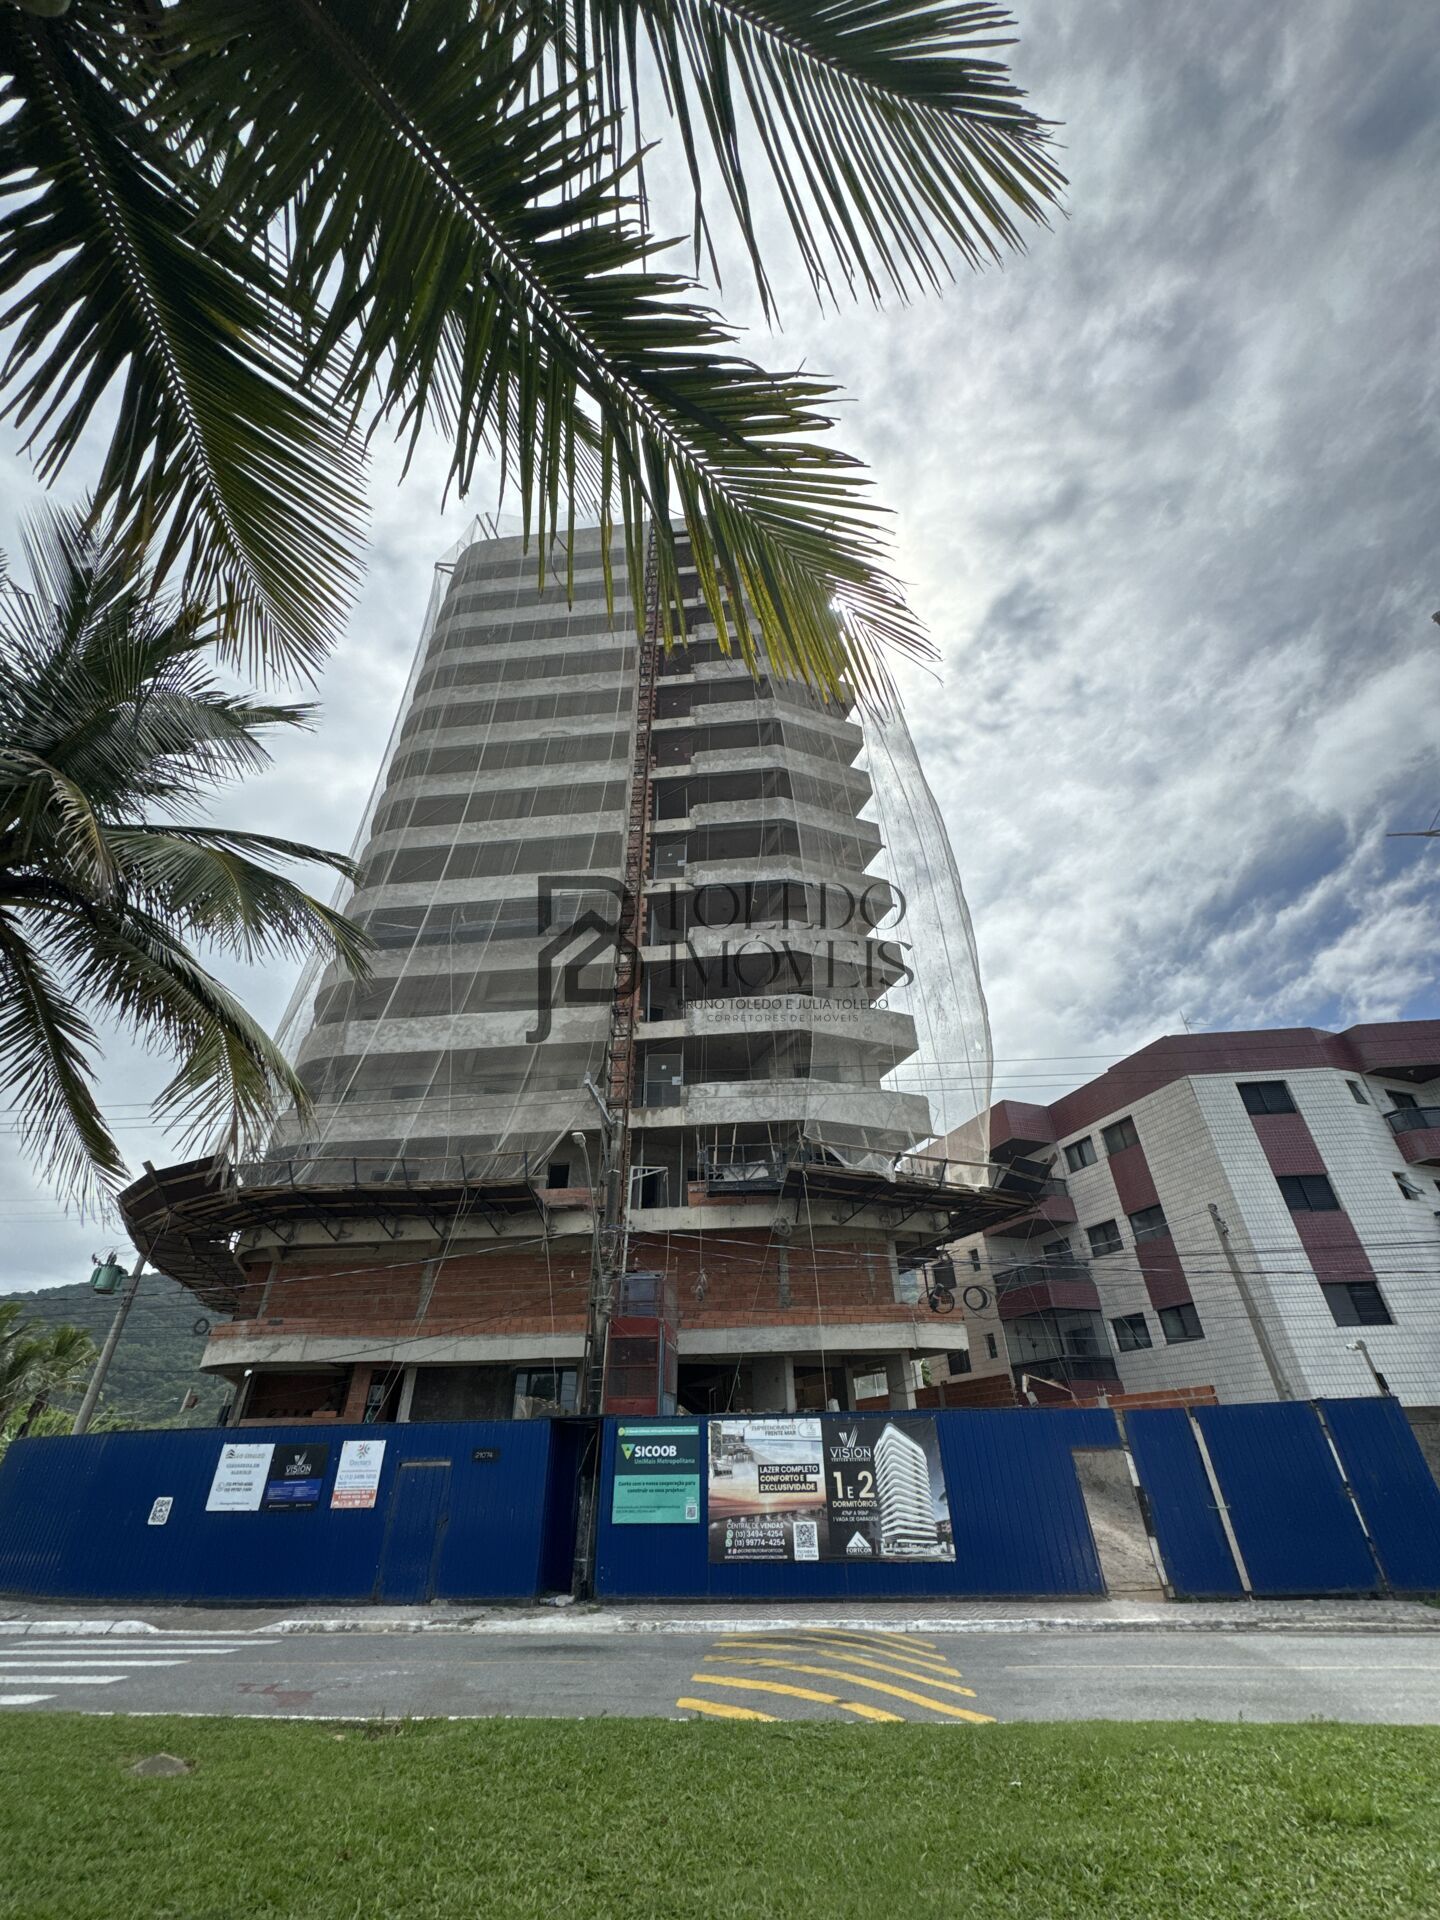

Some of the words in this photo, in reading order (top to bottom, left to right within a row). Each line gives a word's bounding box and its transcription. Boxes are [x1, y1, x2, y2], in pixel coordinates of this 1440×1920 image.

[634, 1445, 677, 1458] SICOOB
[830, 1447, 871, 1458] VISION
[657, 1457, 696, 1466] Metropolitana
[286, 1464, 312, 1473] VISION
[781, 1465, 819, 1473] COMPLETO
[760, 1474, 800, 1482] CONFORTO
[800, 1474, 805, 1482] E
[760, 1483, 816, 1491] EXCLUSIVIDADE
[833, 1471, 844, 1499] 1
[847, 1486, 855, 1499] E
[857, 1470, 876, 1498] 2
[832, 1499, 878, 1508] DORMITÓRIOS
[735, 1530, 746, 1538] (13)
[746, 1530, 784, 1538] 3494-4254
[734, 1539, 745, 1547] (13)
[745, 1538, 786, 1546] 99774-4254
